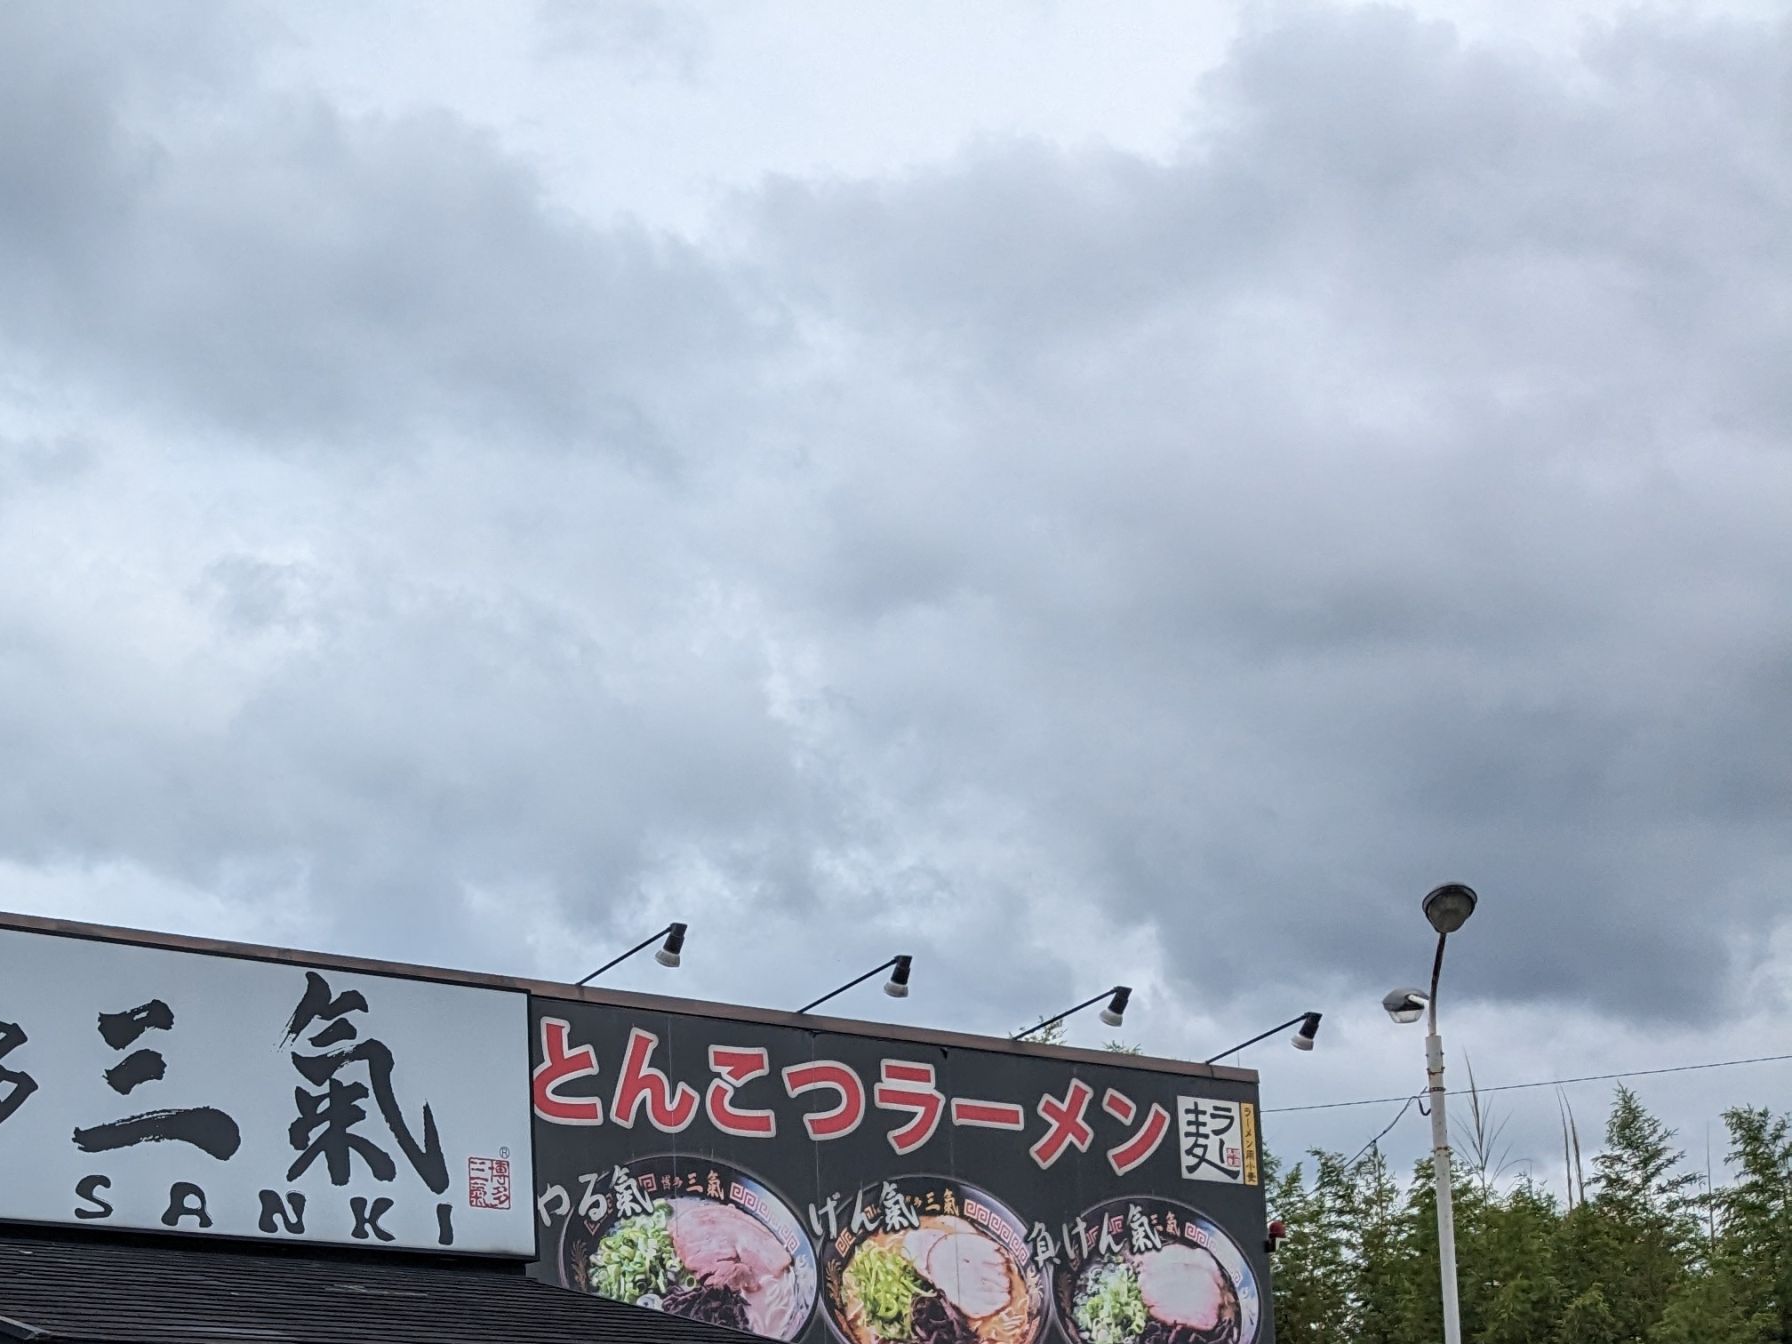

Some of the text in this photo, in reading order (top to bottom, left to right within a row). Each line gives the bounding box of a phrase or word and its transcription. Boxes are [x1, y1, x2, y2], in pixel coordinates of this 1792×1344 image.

[533, 1016, 1171, 1177] とんこつラーメン
[73, 1173, 454, 1246] SANKI
